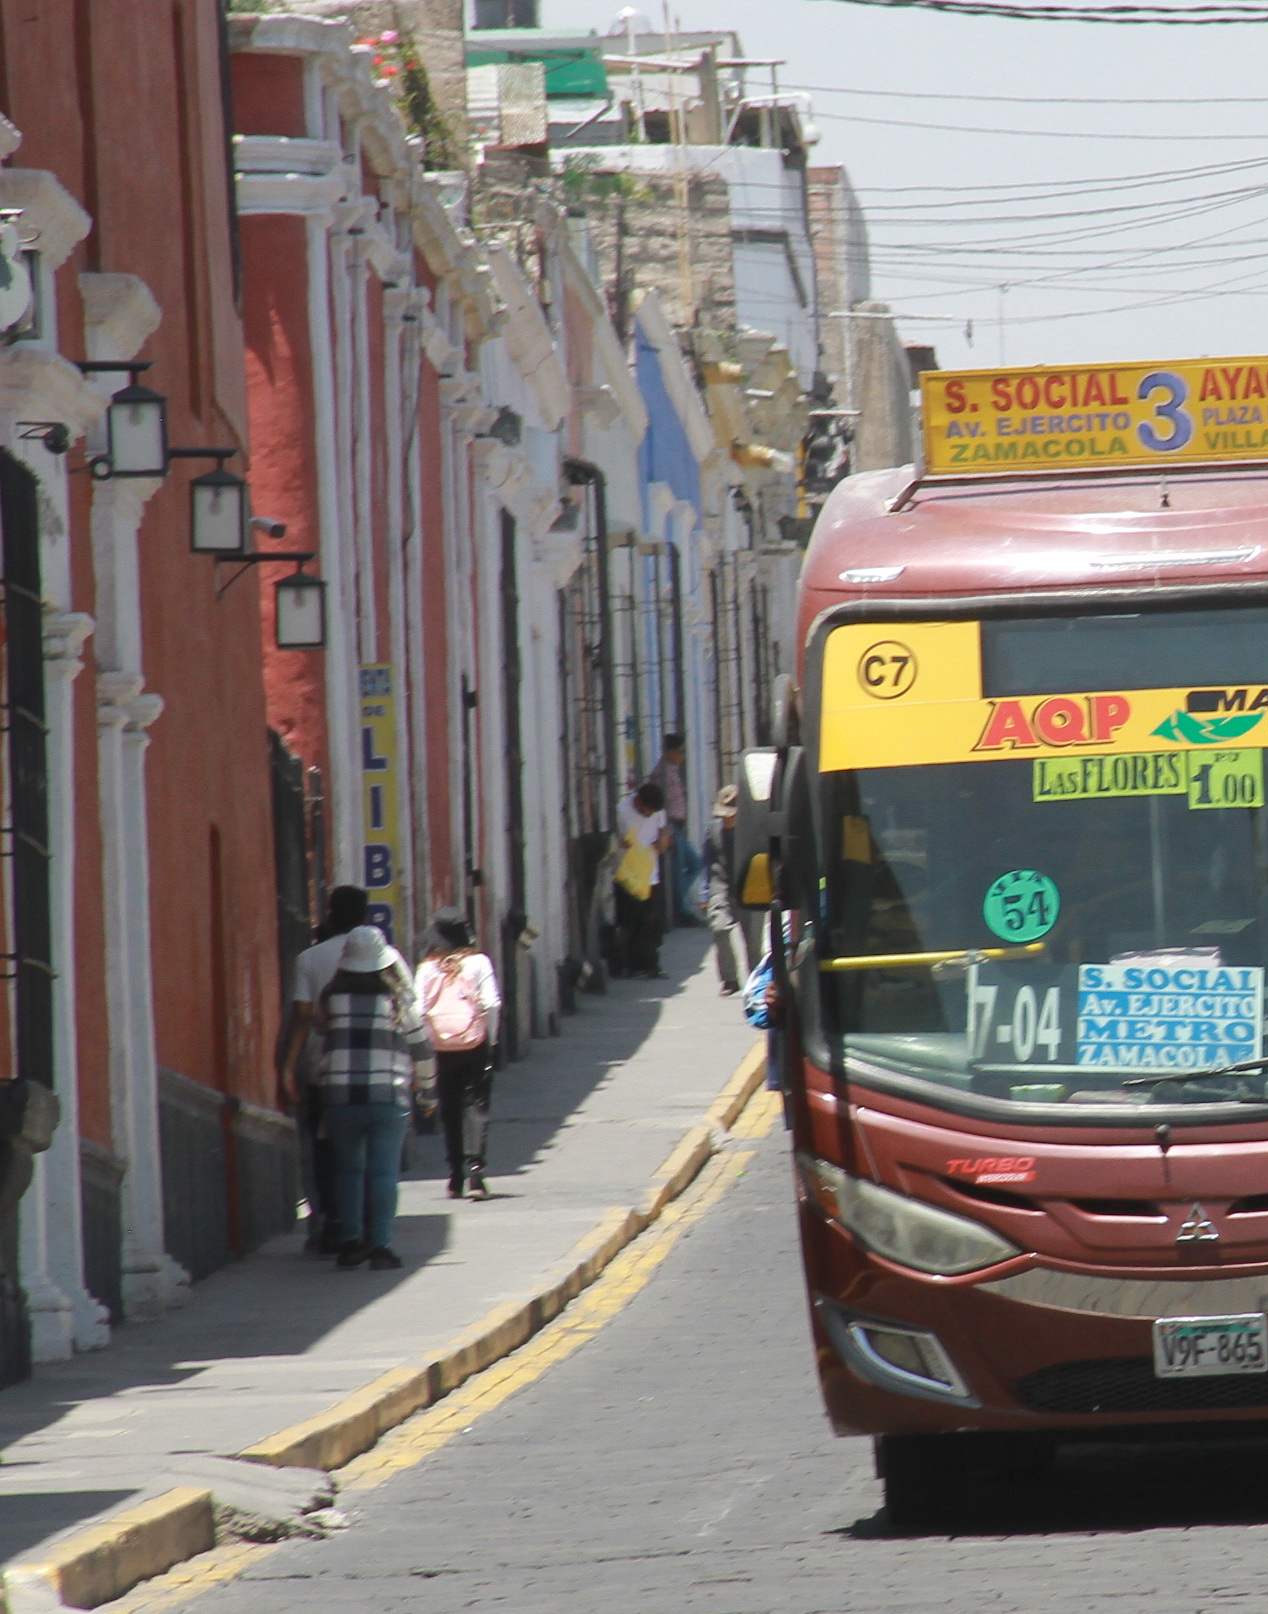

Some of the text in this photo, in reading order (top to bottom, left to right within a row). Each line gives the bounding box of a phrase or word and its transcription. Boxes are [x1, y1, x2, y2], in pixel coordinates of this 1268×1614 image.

[945, 373, 1129, 414] S. SOCIAL
[1136, 370, 1192, 451] 3
[1203, 406, 1264, 427] PLAZA
[996, 412, 1131, 437] EJERCITO
[951, 437, 1129, 463] ZAMACOLA
[863, 654, 910, 688] C7
[972, 696, 1132, 752] AQP
[1003, 890, 1048, 931] 54
[1083, 967, 1256, 991] S. SOCIAL
[1127, 994, 1256, 1018] EJERCITO
[1080, 1019, 1256, 1042] METRO
[1079, 1044, 1233, 1068] ZAMACOLA
[946, 1155, 1037, 1175] TURBO
